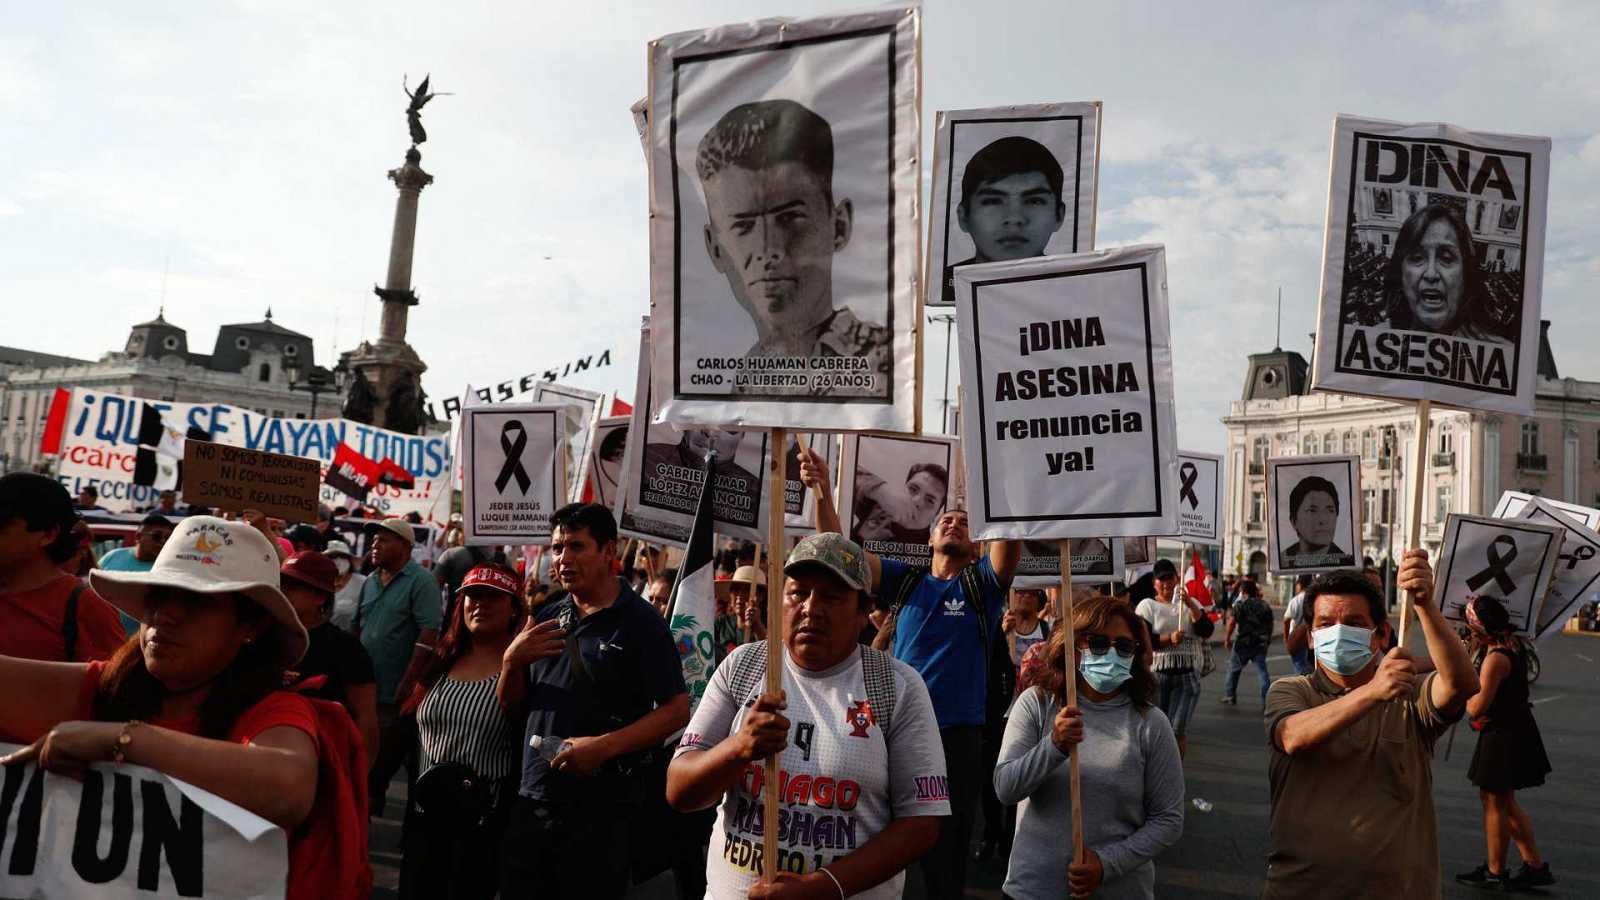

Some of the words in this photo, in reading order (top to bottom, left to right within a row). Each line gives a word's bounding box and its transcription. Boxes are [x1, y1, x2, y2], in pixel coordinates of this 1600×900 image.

[1364, 140, 1517, 201] DINA
[1019, 316, 1106, 356] ¡DINA
[696, 357, 744, 370] CARLOS
[747, 357, 806, 370] HUAMAN
[810, 357, 869, 371] CABRERA
[1343, 328, 1510, 389] ASESINA
[690, 373, 723, 386] CHAO
[735, 374, 750, 386] LA
[752, 374, 808, 387] LIBERTAD
[811, 374, 832, 389] (26
[995, 362, 1140, 402] ASESINA
[74, 395, 172, 446] ¡QU
[243, 413, 346, 460] VAYAN
[996, 409, 1143, 441] renuncia
[196, 445, 215, 460] NO
[1045, 447, 1095, 476] ya!
[220, 465, 236, 480] NI
[656, 463, 705, 483] GABRIEL
[199, 481, 242, 501] SOMOS
[249, 488, 314, 511] REALISTAS
[650, 475, 690, 497] LÓPEZ
[481, 513, 510, 522] LUQUE
[511, 513, 548, 522] MAMANI
[488, 502, 514, 511] JEDER
[863, 540, 904, 553] NELSON
[723, 831, 805, 876] PEDRTO
